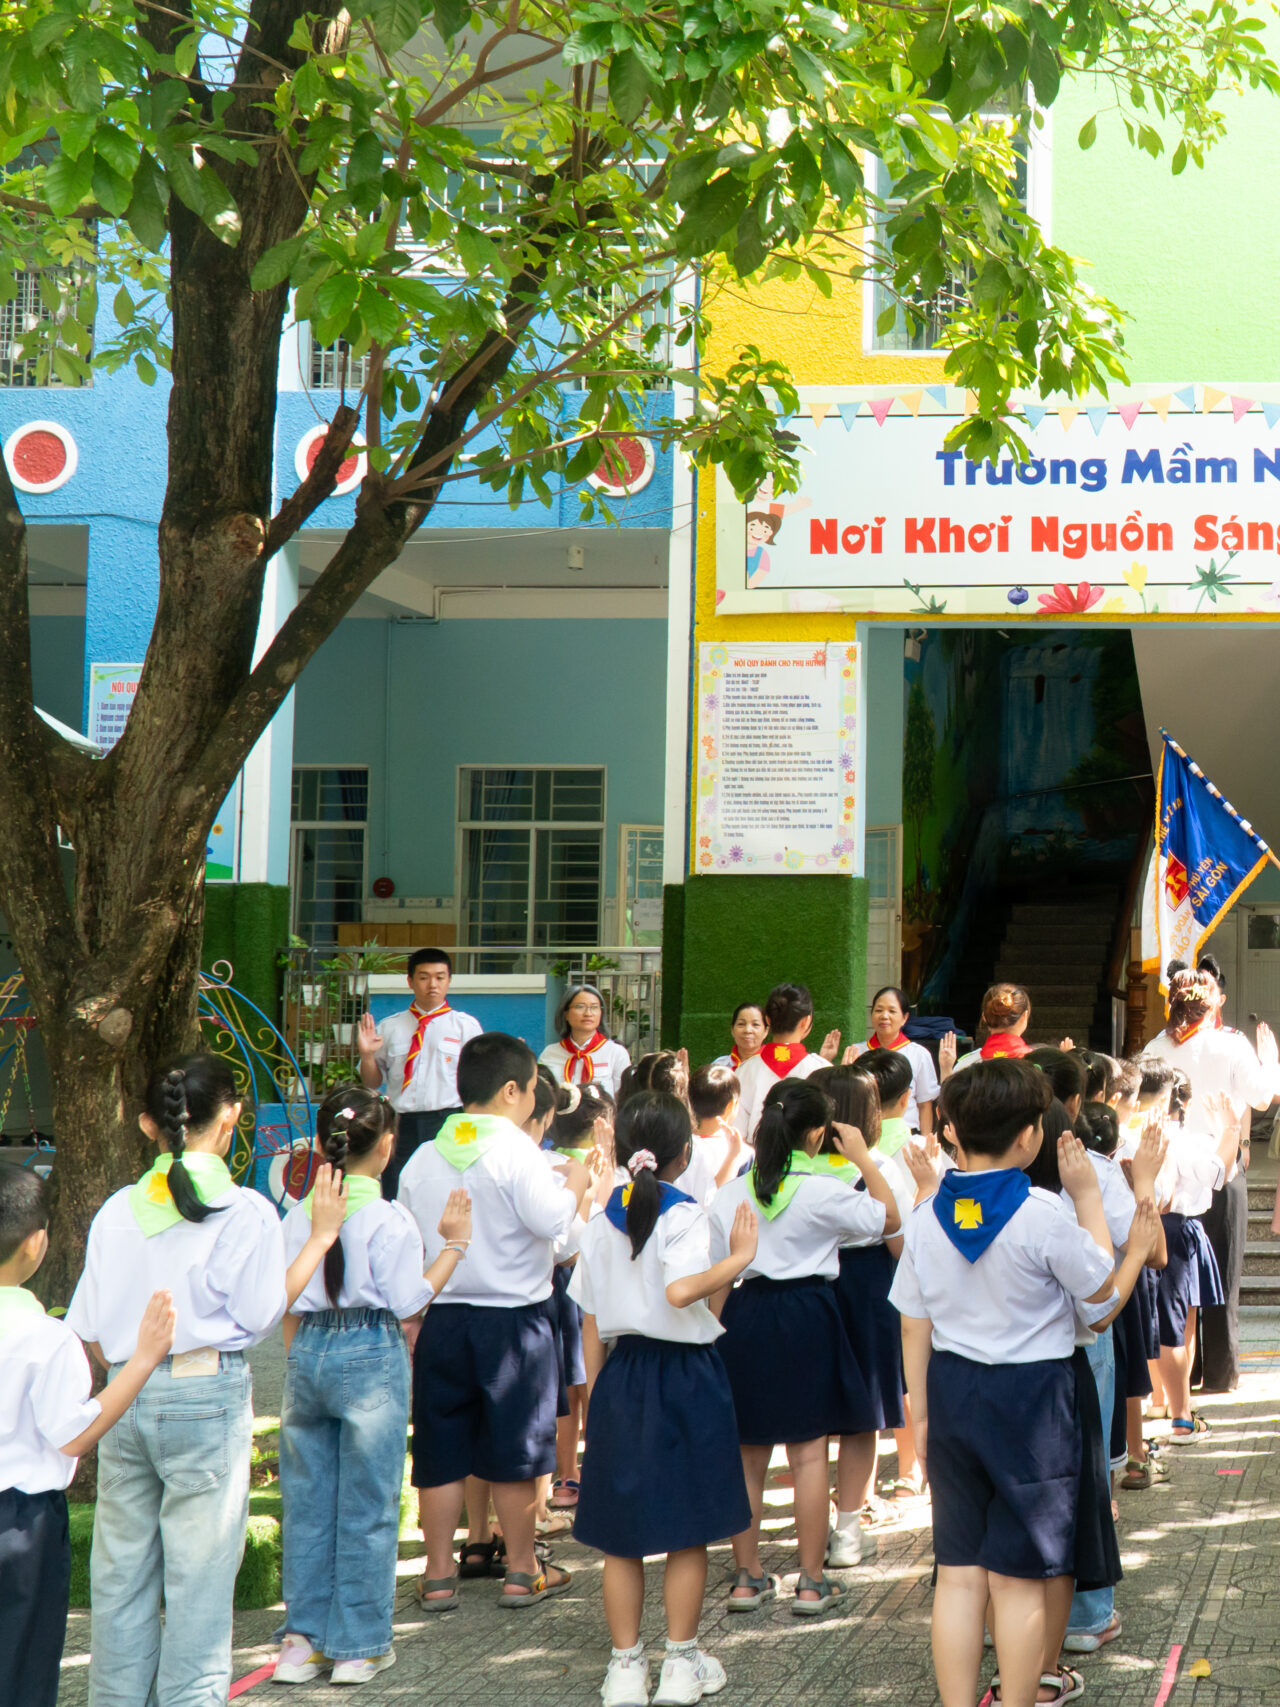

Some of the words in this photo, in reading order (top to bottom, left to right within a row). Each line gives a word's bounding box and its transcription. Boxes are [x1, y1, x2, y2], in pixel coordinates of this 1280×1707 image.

[936, 450, 1107, 492] Trường
[1121, 442, 1237, 485] Mầm
[810, 516, 886, 554] Nơi
[904, 515, 1013, 553] Khơi
[1031, 510, 1173, 559] Nguồn
[746, 659, 759, 667] QUY
[778, 659, 791, 667] CHO
[1191, 886, 1210, 907] SÀI
[1205, 861, 1228, 887] GÒN
[1196, 856, 1214, 873] YÊN
